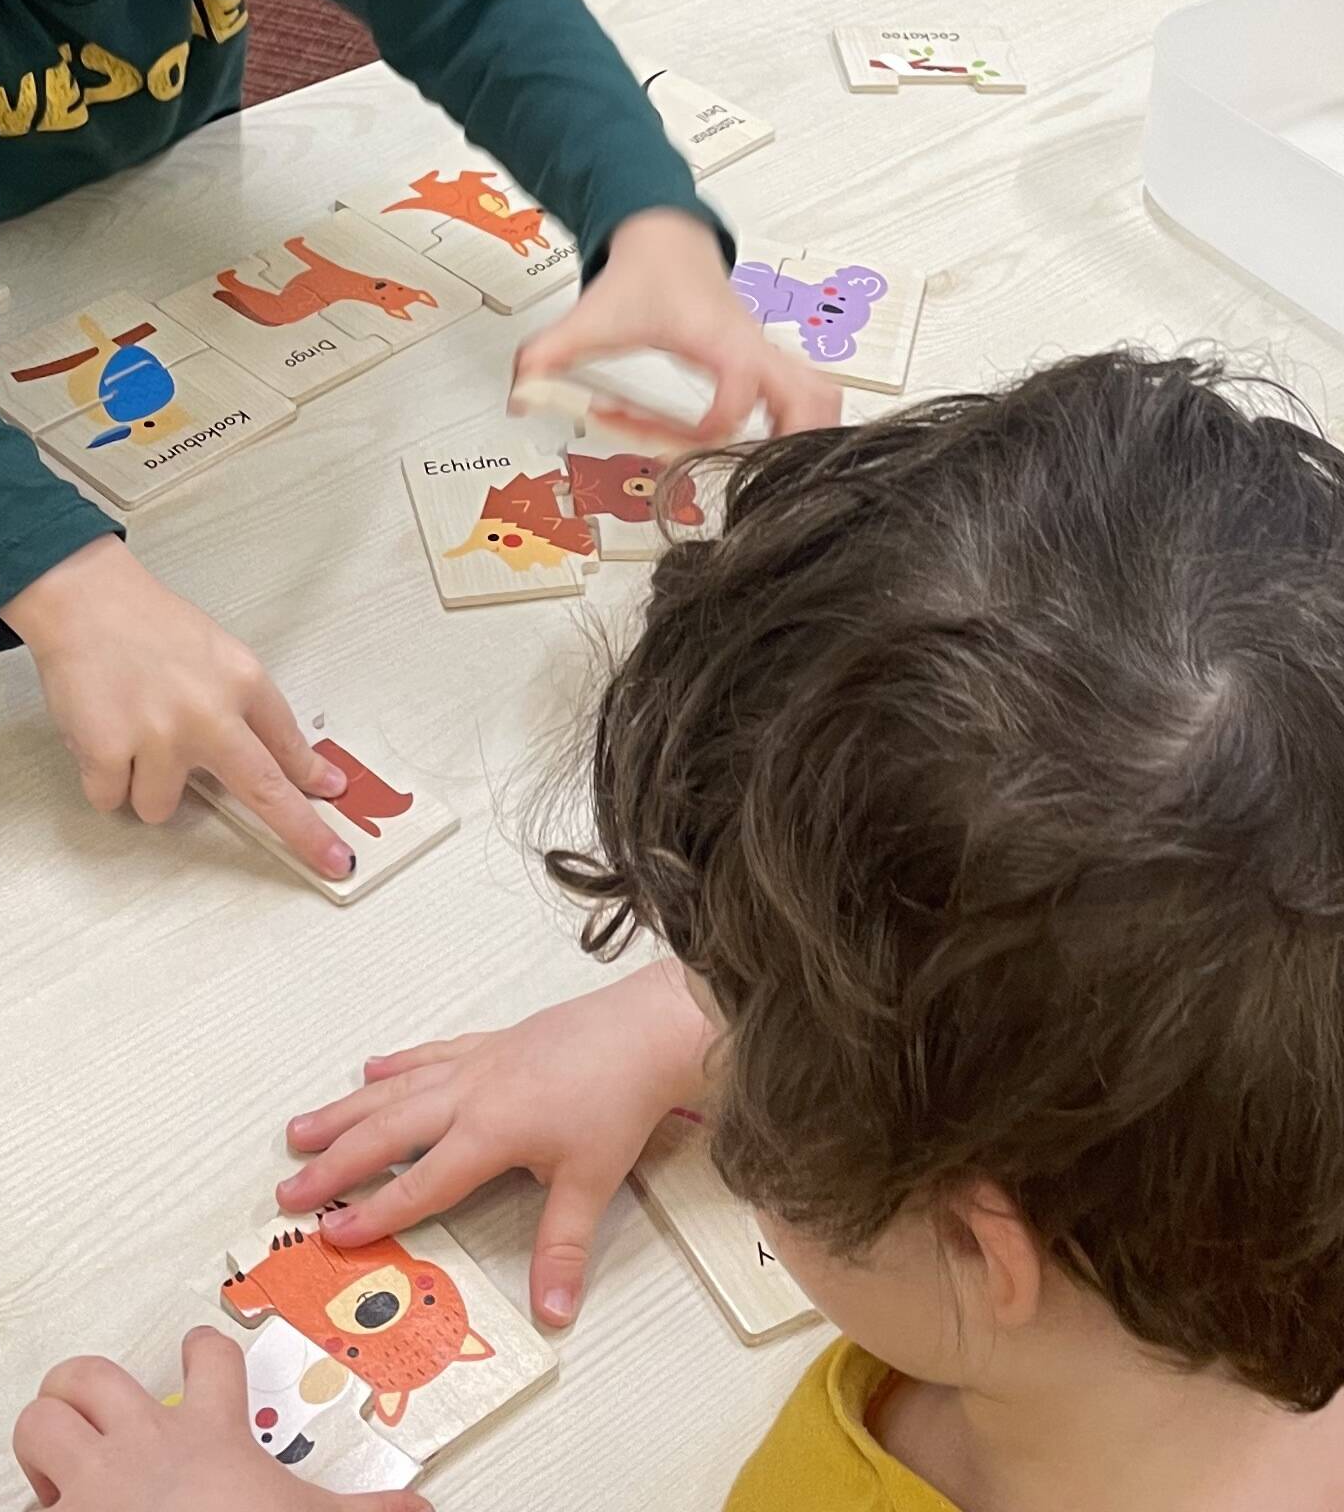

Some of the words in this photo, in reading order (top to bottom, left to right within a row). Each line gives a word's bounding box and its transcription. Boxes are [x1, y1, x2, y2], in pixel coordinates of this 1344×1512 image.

[881, 31, 960, 42] Cockatoo
[695, 104, 728, 124] Devil
[689, 115, 746, 144] Tasmanian
[526, 242, 577, 276] ngaroo
[285, 339, 337, 368] Dingo
[144, 409, 252, 470] Kookaburra
[423, 455, 511, 476] Echidna
